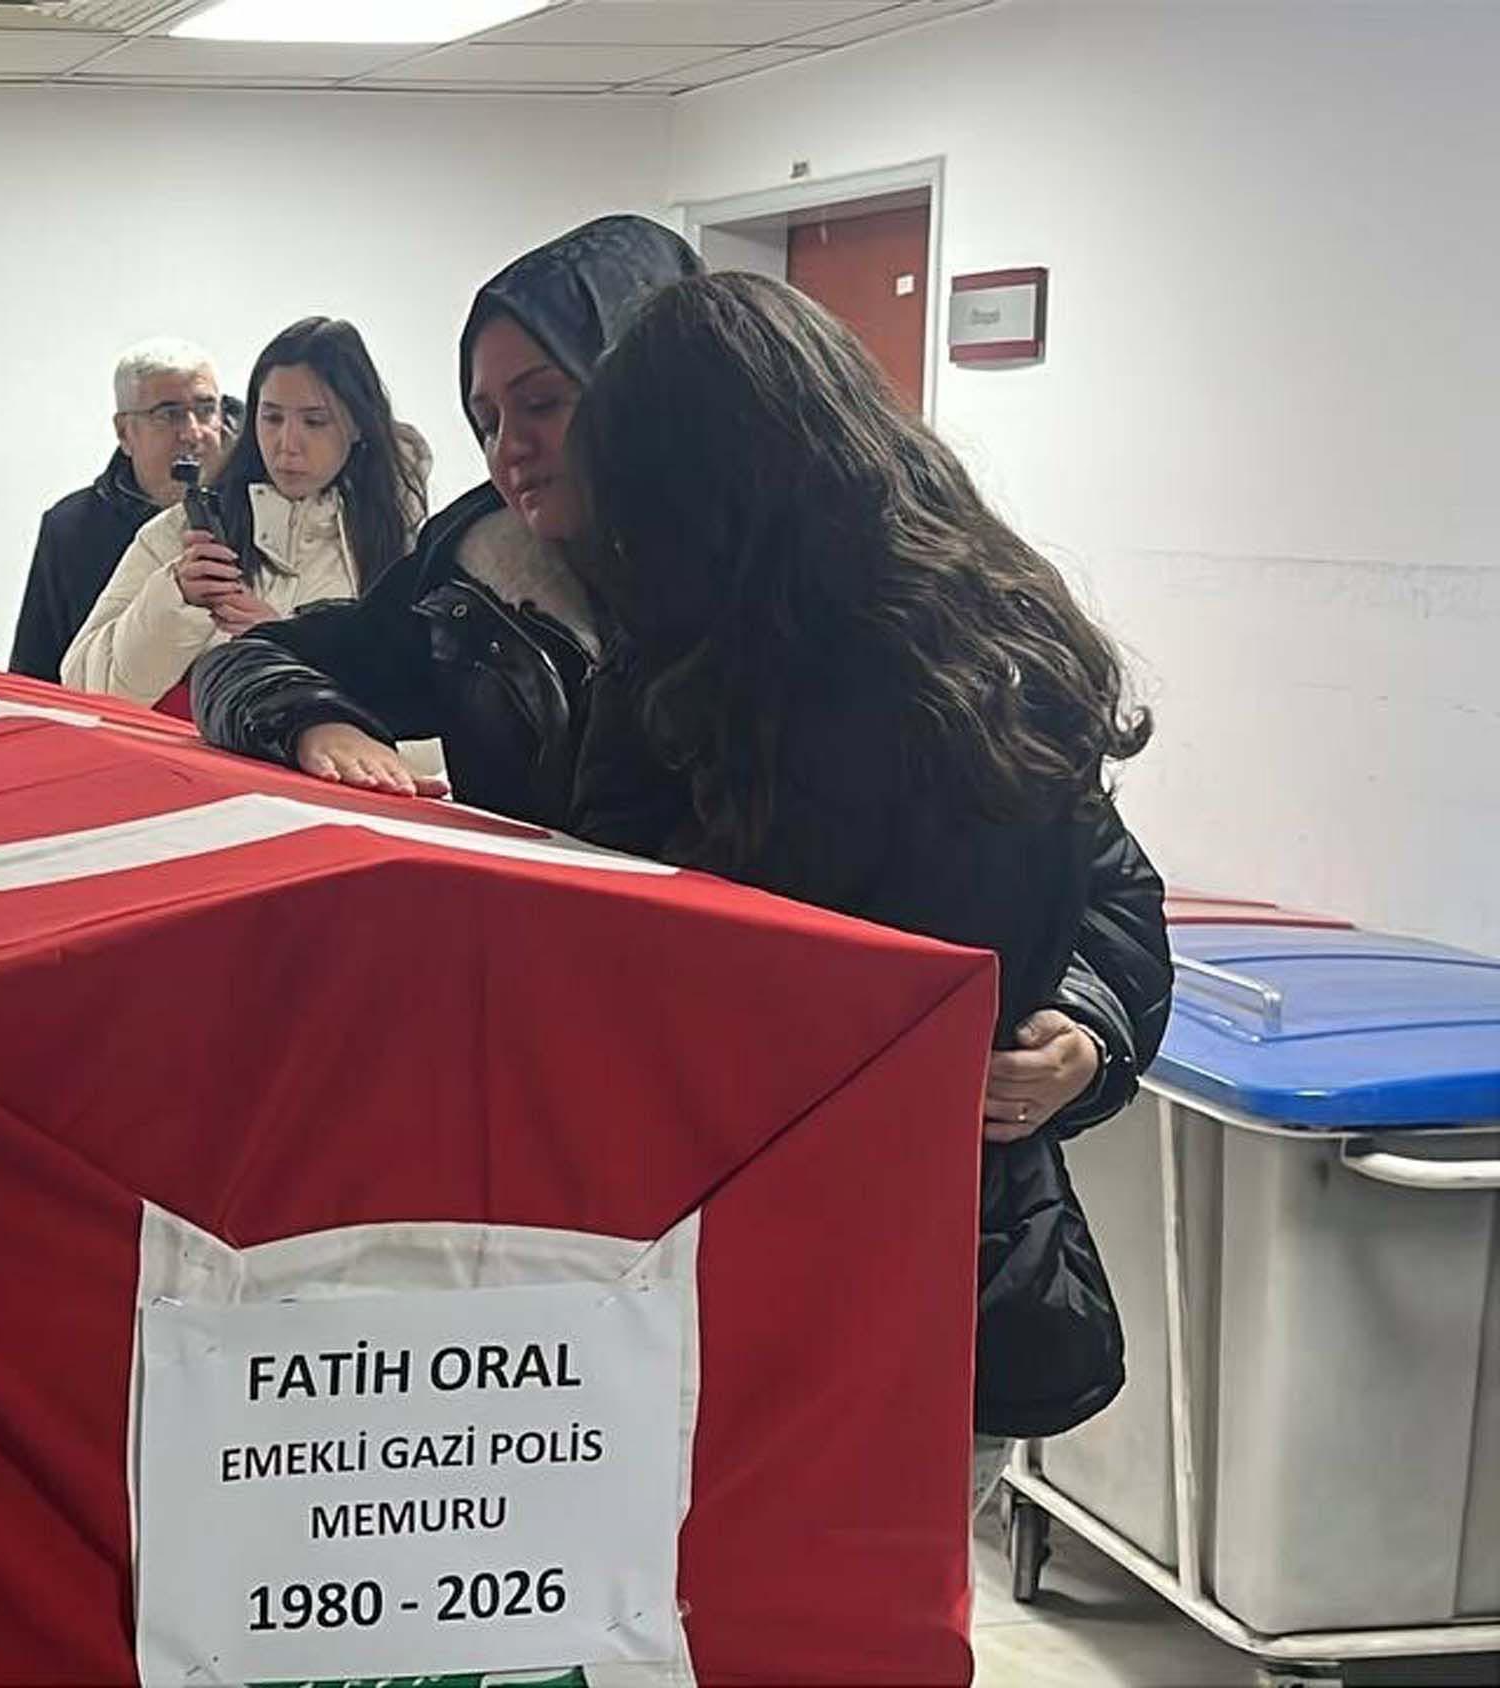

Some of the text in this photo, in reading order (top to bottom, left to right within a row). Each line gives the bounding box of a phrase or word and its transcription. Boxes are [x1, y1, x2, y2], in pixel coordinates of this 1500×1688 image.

[249, 1339, 582, 1401] FATİH ORAL
[222, 1422, 603, 1483] EMEKLİ GAZİ POLİS
[311, 1496, 507, 1539] MEMURU
[249, 1580, 383, 1631] 1980
[437, 1567, 566, 1622] 2026
